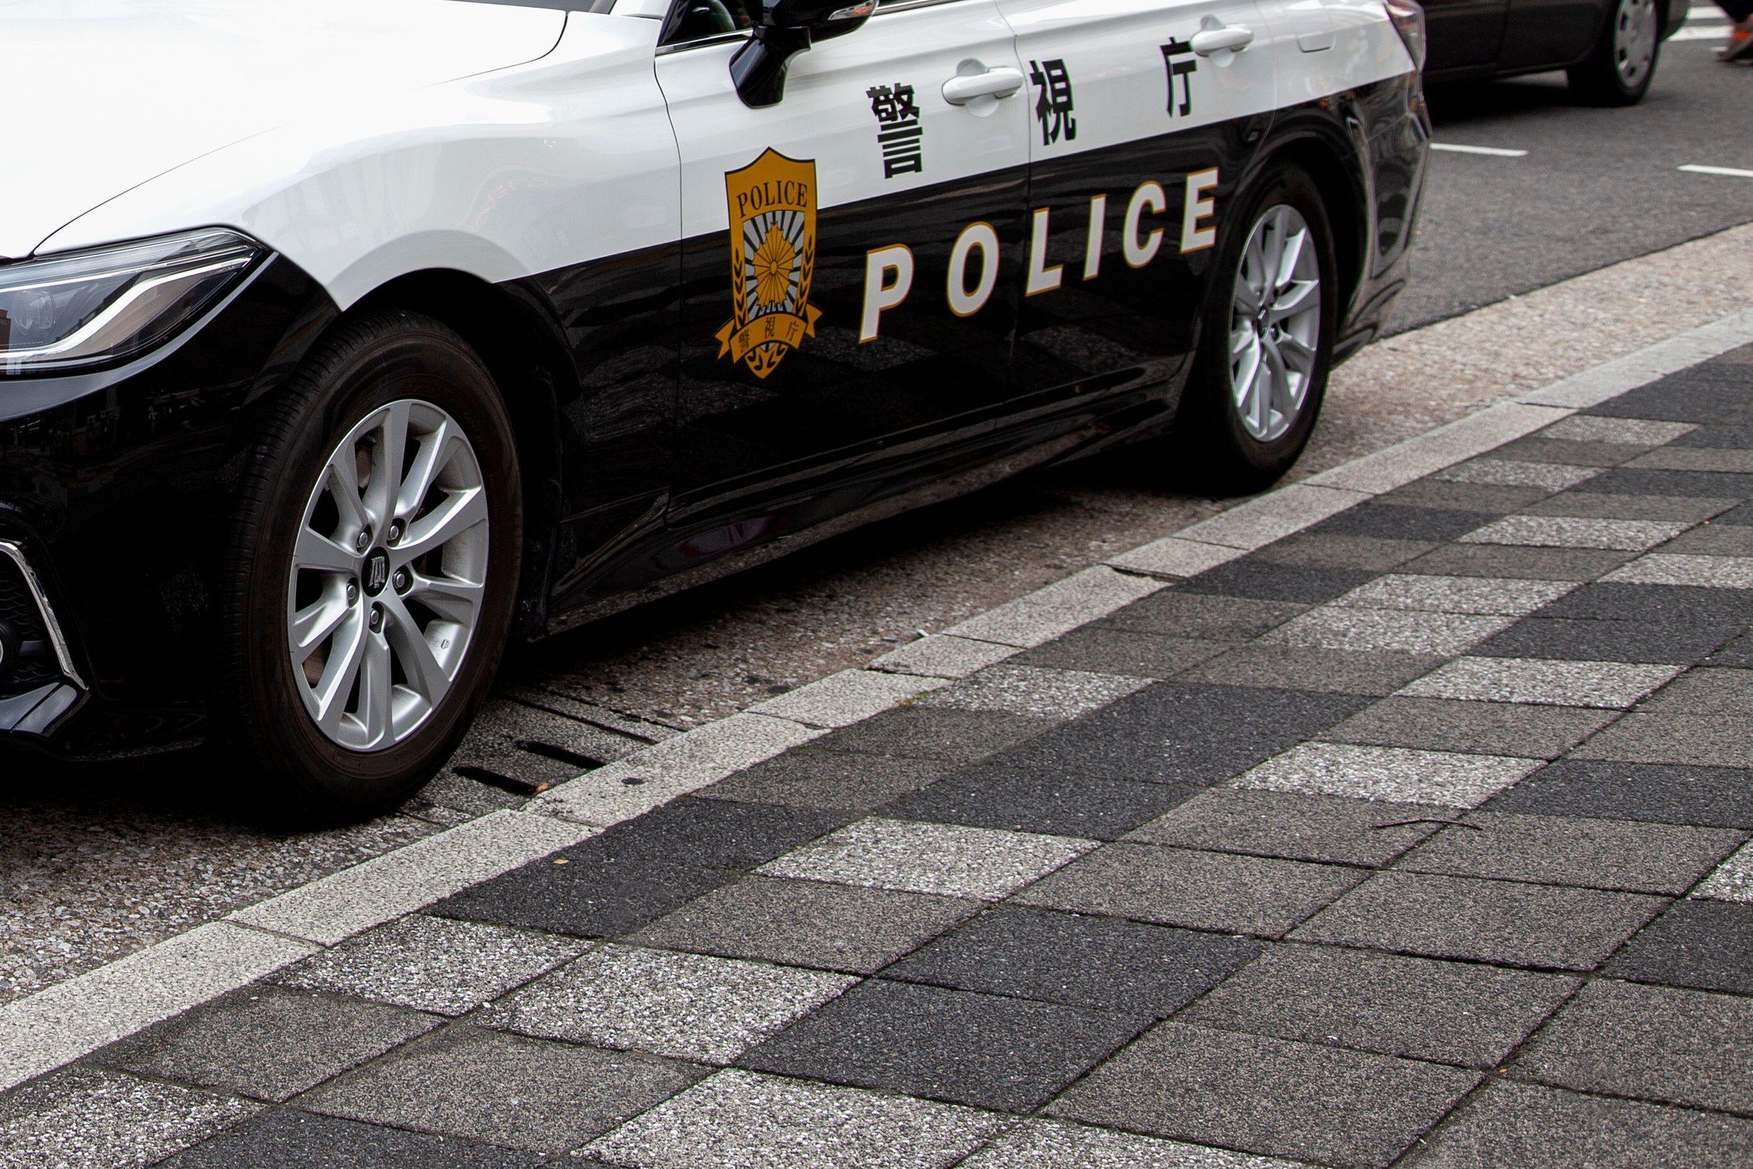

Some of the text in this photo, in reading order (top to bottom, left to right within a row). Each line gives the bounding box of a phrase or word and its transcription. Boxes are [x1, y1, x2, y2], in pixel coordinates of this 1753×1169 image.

[866, 36, 1198, 180] 警視庁
[736, 179, 809, 220] POLICE
[859, 167, 1219, 344] POLICE
